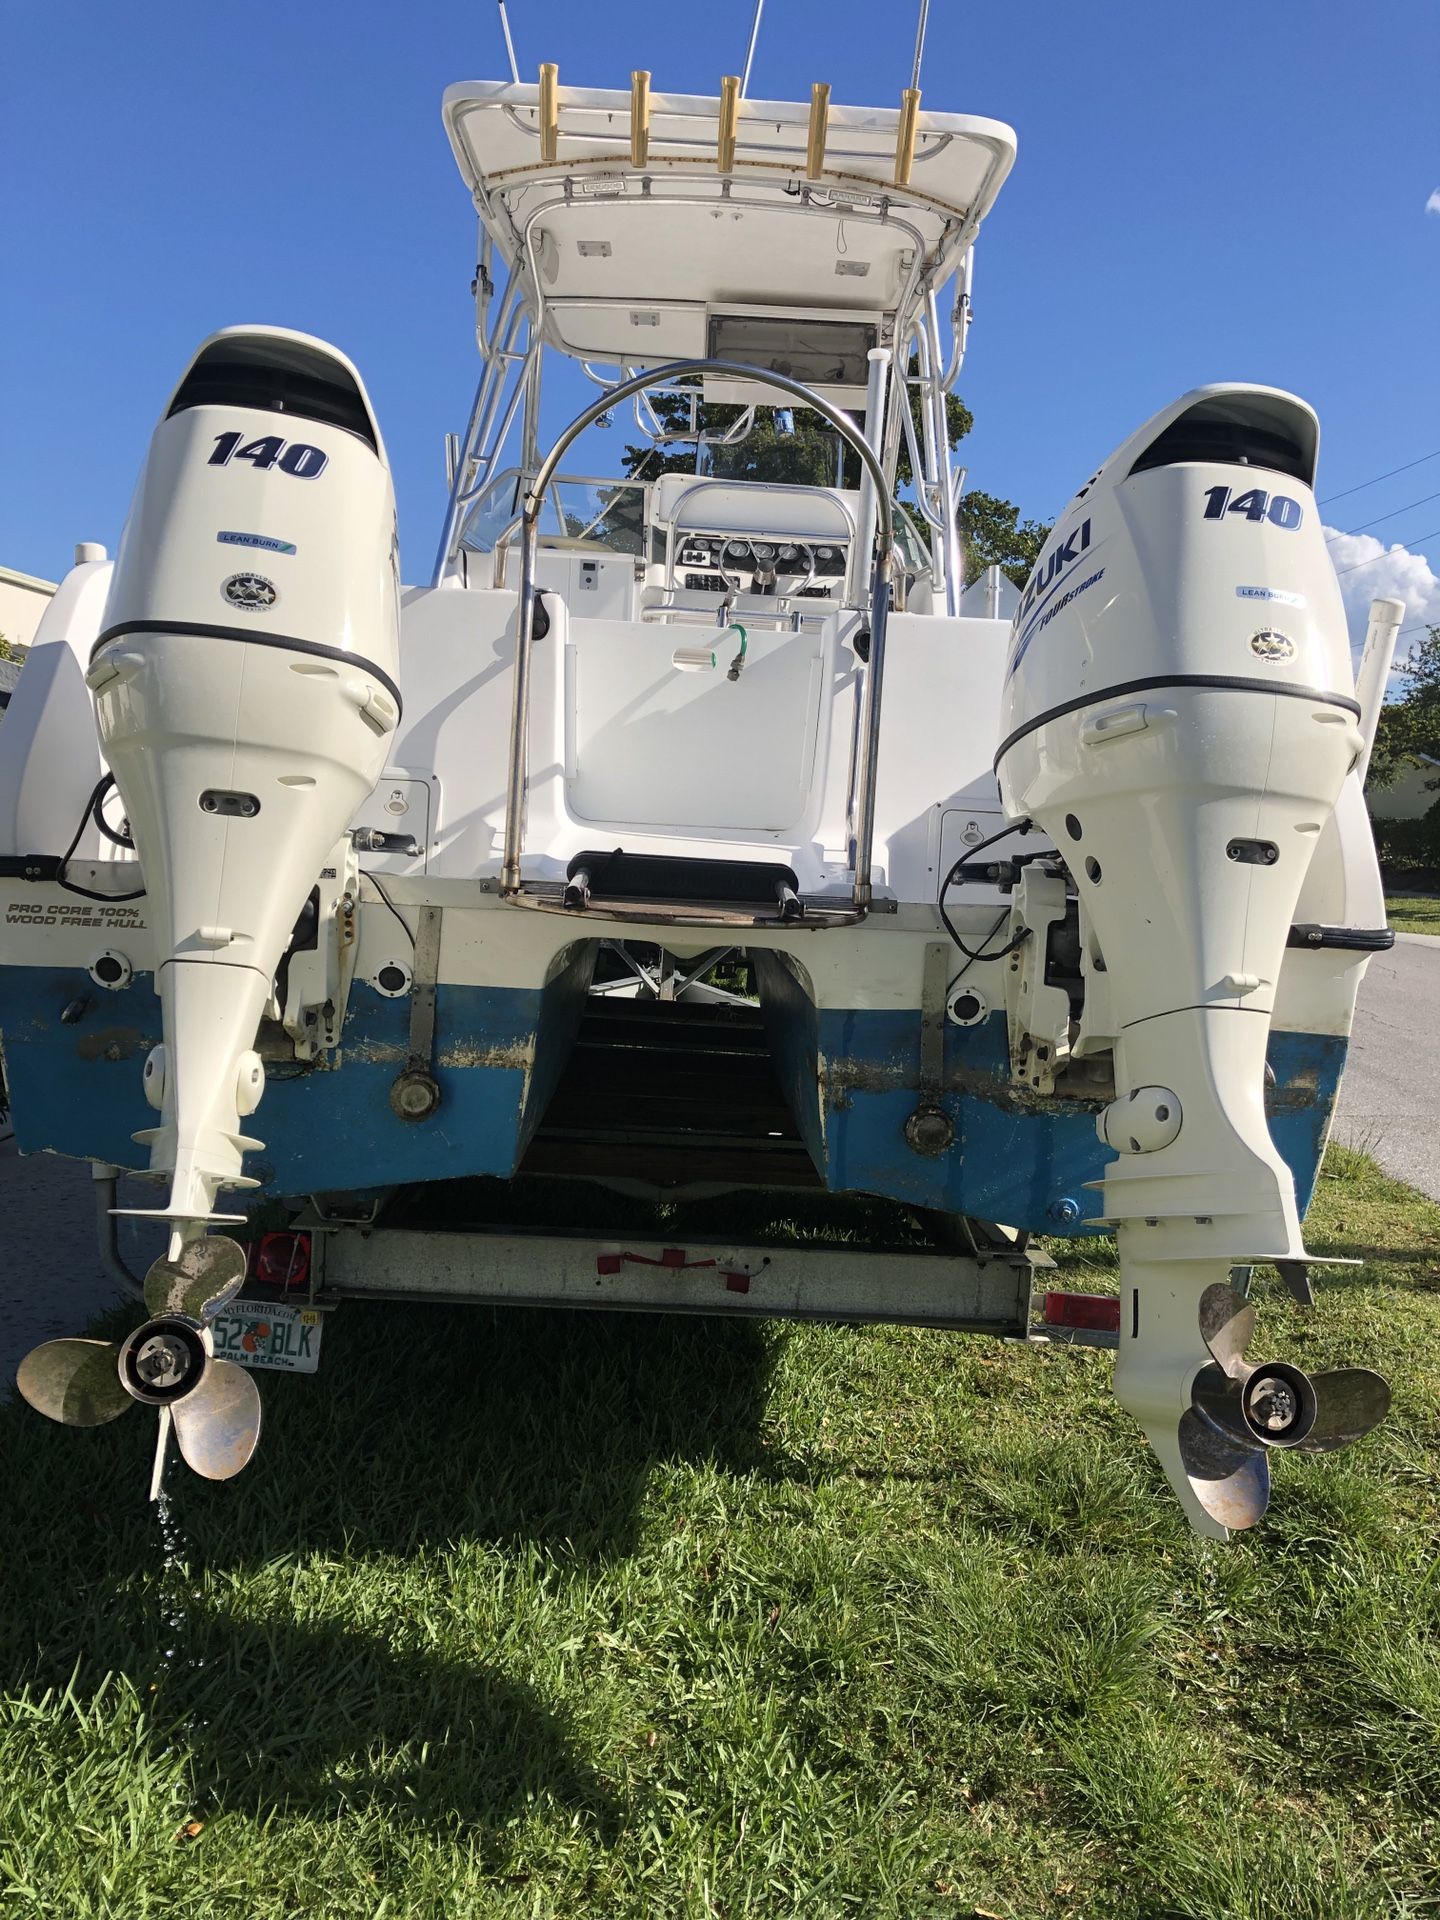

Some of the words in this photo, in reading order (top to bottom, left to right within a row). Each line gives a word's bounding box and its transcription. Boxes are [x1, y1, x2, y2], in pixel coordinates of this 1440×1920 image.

[207, 431, 330, 480] 140
[1203, 486, 1303, 531] 140
[223, 534, 250, 544] LEAN
[252, 538, 279, 549] BURN
[1242, 588, 1266, 597] LEAN
[8, 903, 42, 913] PRO
[47, 905, 93, 916] CORE
[98, 907, 140, 918] 100%
[5, 914, 56, 925] WOOD
[60, 917, 103, 927] FREE
[106, 919, 148, 929] HULL
[271, 1322, 314, 1358] BLK
[220, 1351, 248, 1362] PALM
[252, 1355, 288, 1367] BEACH
